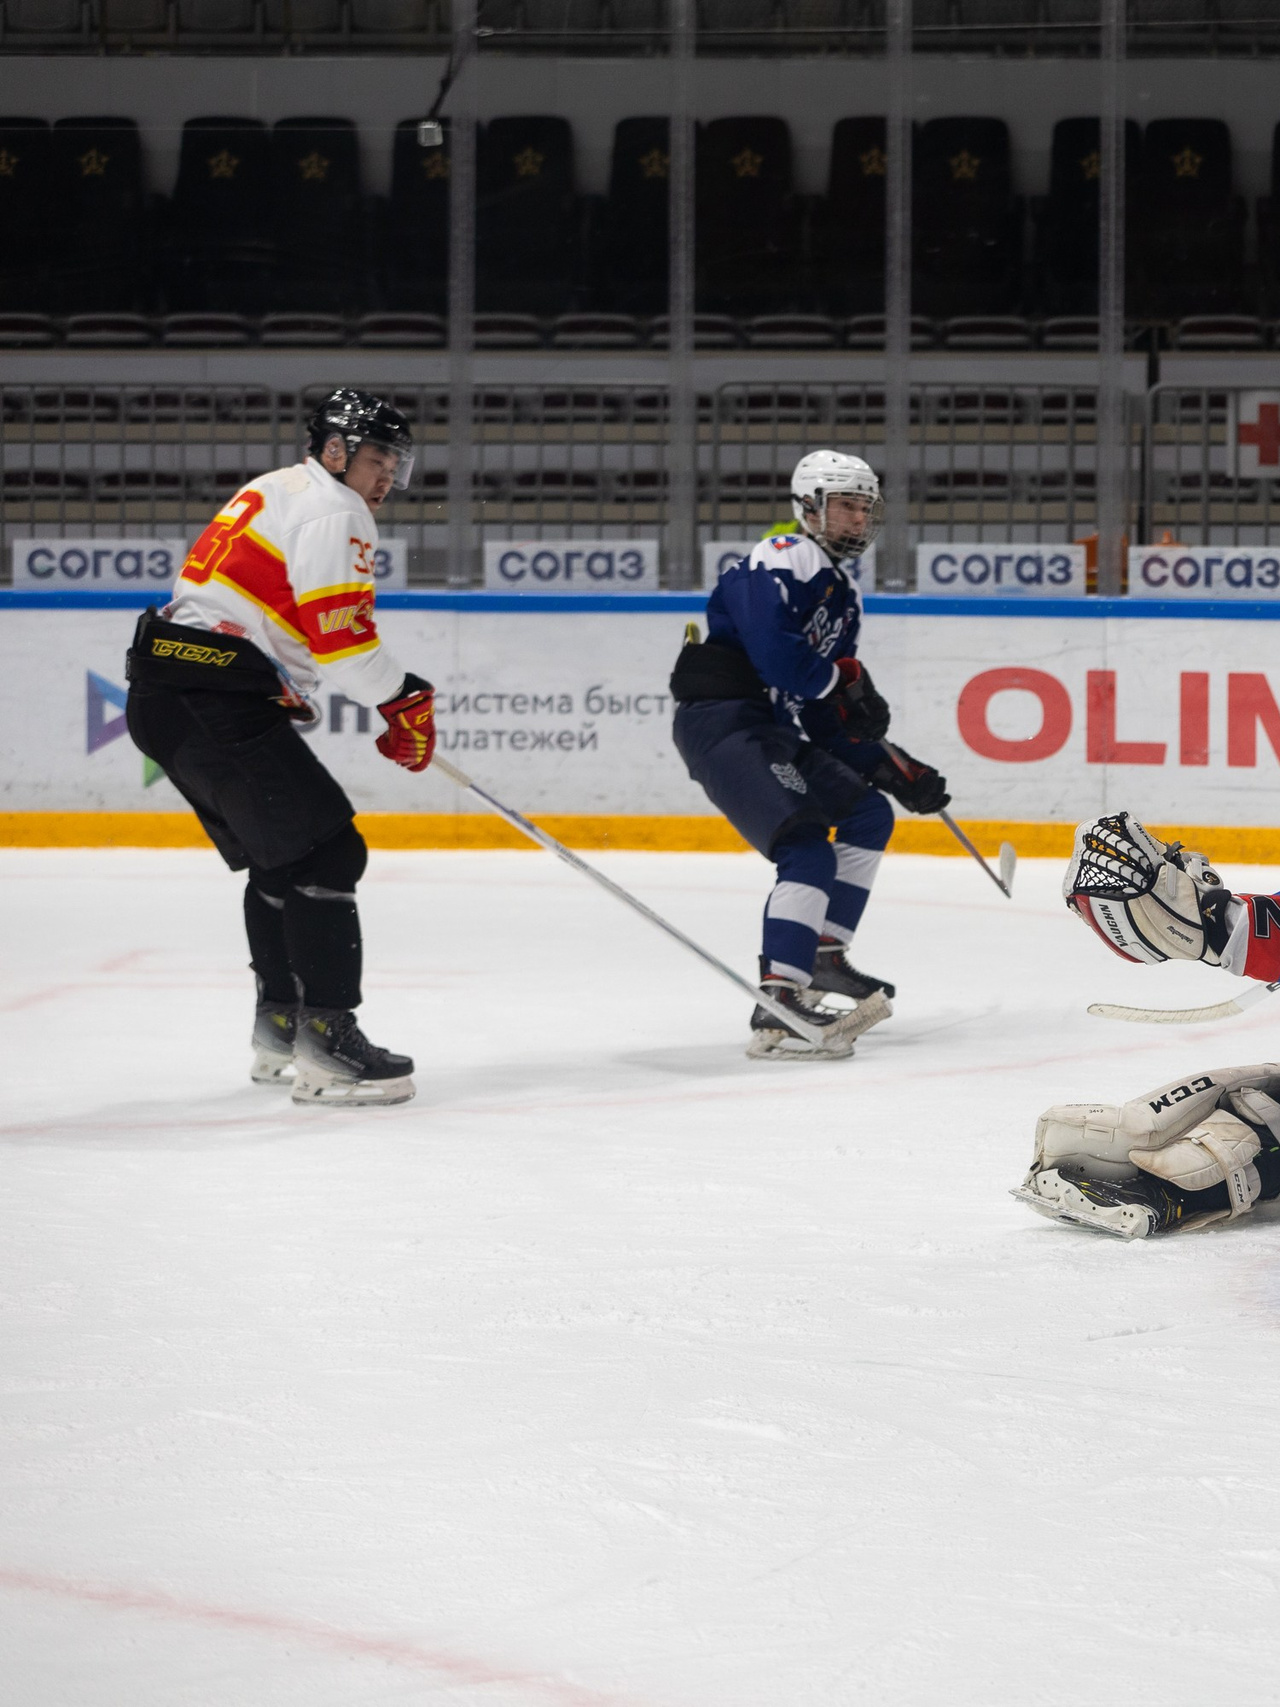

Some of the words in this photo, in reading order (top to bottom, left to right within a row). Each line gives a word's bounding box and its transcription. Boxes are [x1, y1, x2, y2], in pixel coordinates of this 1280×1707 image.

[153, 638, 238, 667] CCM
[584, 684, 675, 716] быст
[1098, 903, 1129, 947] VAUGHN
[1149, 1076, 1217, 1115] CCM
